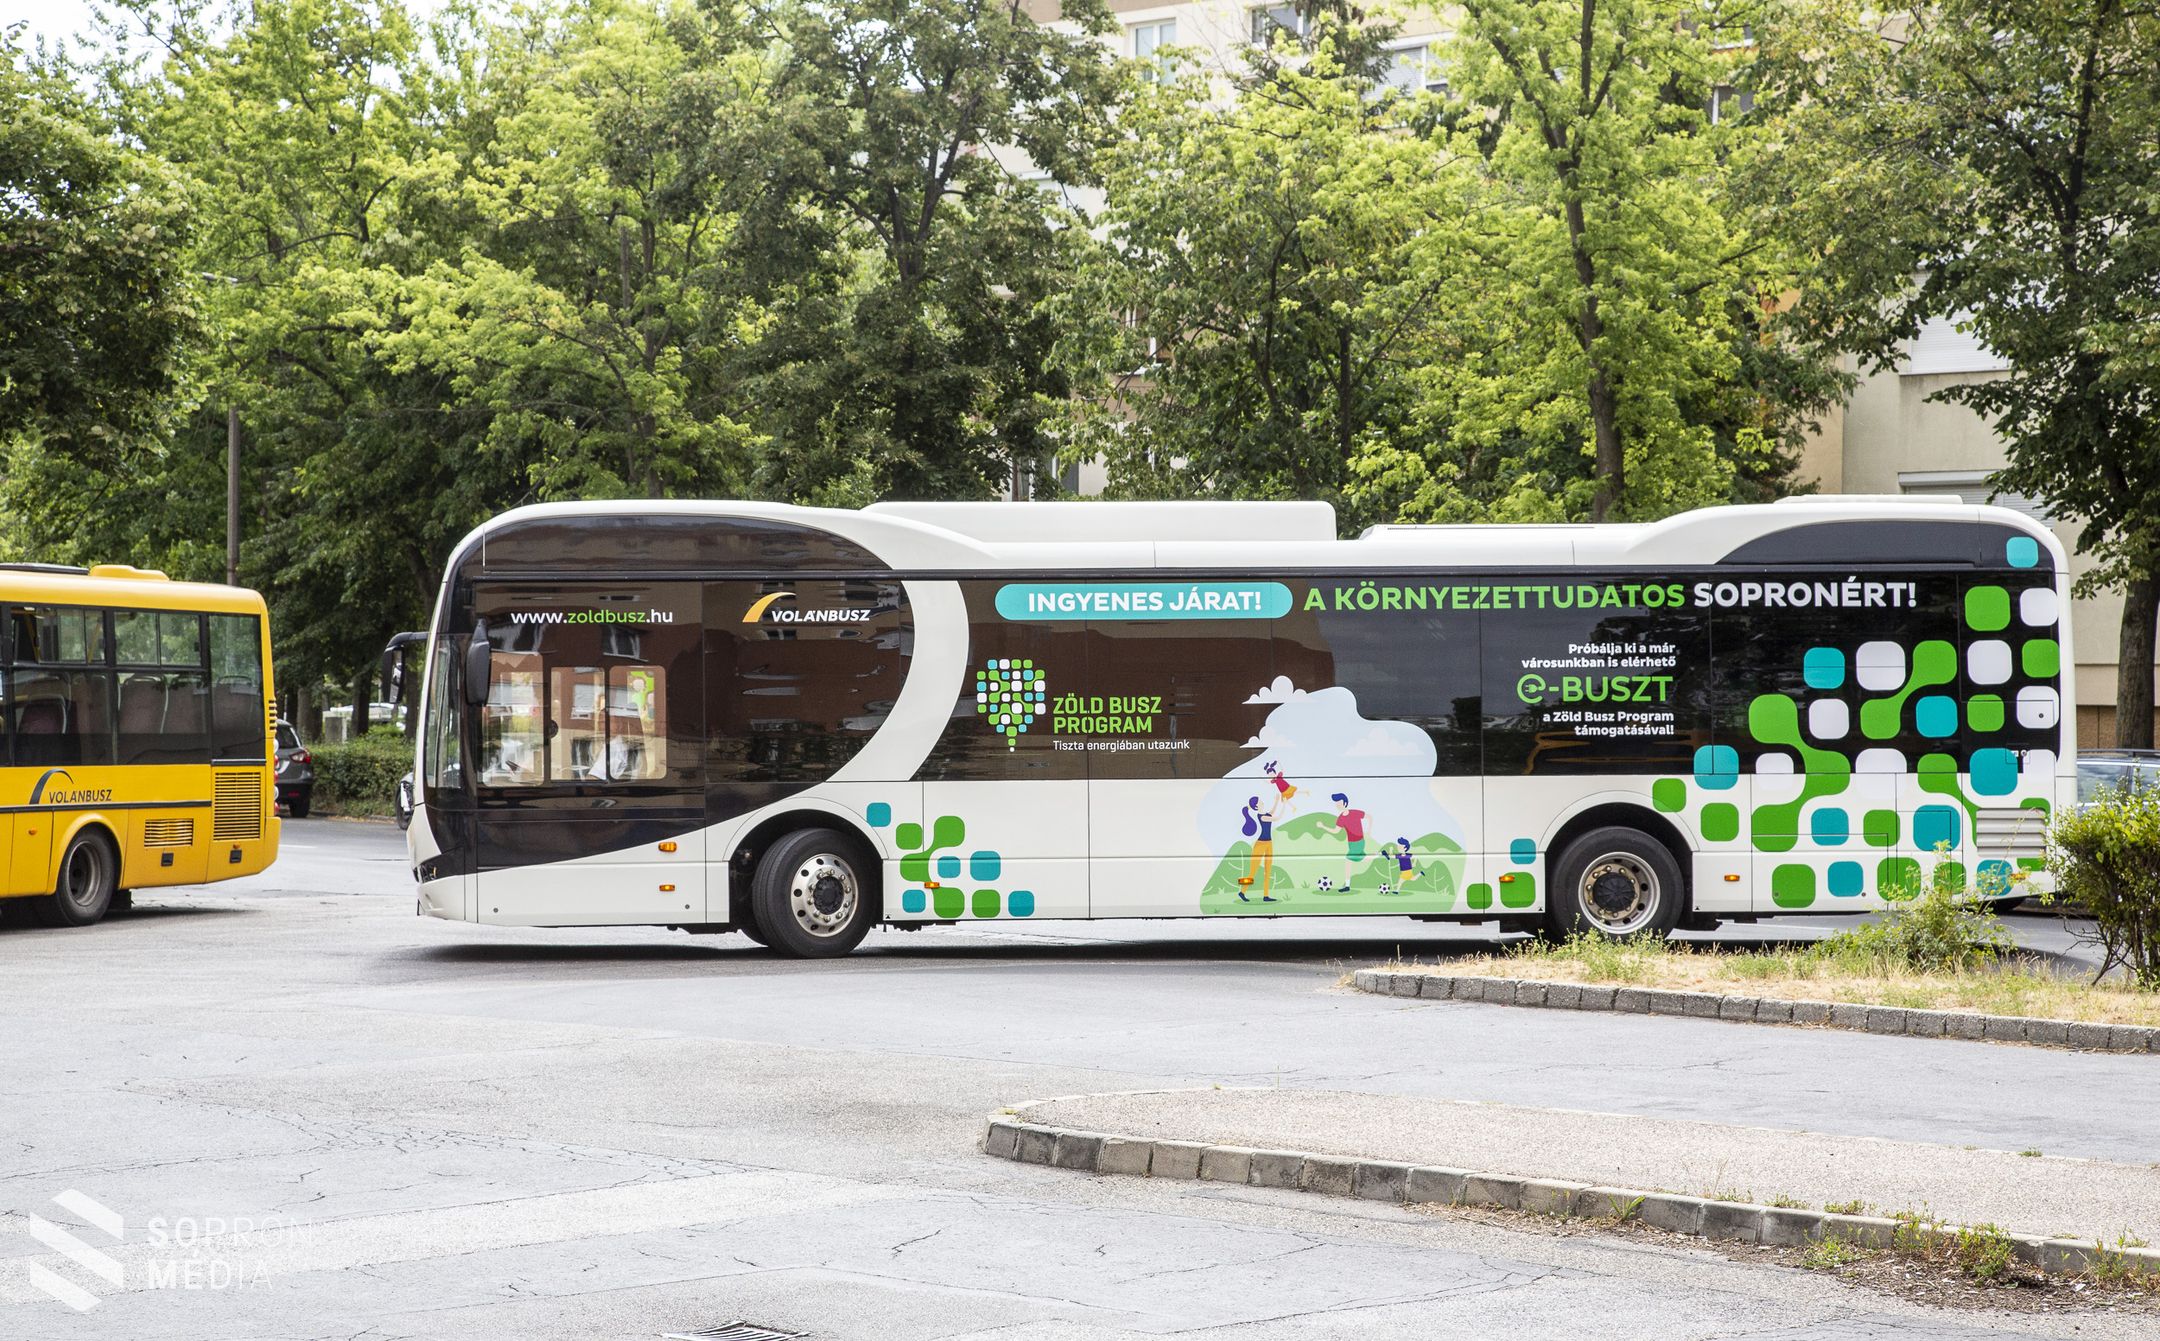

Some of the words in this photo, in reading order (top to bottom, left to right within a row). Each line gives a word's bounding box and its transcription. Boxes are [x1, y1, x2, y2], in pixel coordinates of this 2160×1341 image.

[1028, 592, 1163, 612] INGYENES
[1169, 586, 1262, 611] JÁRAT!
[1303, 588, 1326, 611] A
[1335, 581, 1685, 611] KÖRNYEZETTUDATOS
[1693, 576, 1917, 608] SOPRONÉRT!
[510, 609, 673, 624] www.zoldbusz.hu
[1568, 643, 1622, 656] Próbálja
[1624, 643, 1637, 654] ki
[1638, 645, 1647, 654] a
[1649, 643, 1676, 654] már
[1521, 657, 1605, 668] városunkban
[1607, 657, 1618, 667] is
[1621, 656, 1676, 667] elérhető
[1053, 693, 1104, 714] ZÖLD
[1109, 697, 1162, 714] BUSZ
[1053, 716, 1152, 734] PROGRAM
[1542, 713, 1550, 722] a
[1552, 711, 1582, 722] Zöld
[1584, 712, 1615, 722] Busz
[1617, 712, 1674, 725] Program
[1574, 724, 1674, 738] támogatásával!
[1053, 740, 1084, 751] Tiszta
[1087, 740, 1145, 753] energiában
[1148, 740, 1190, 750] utazunk
